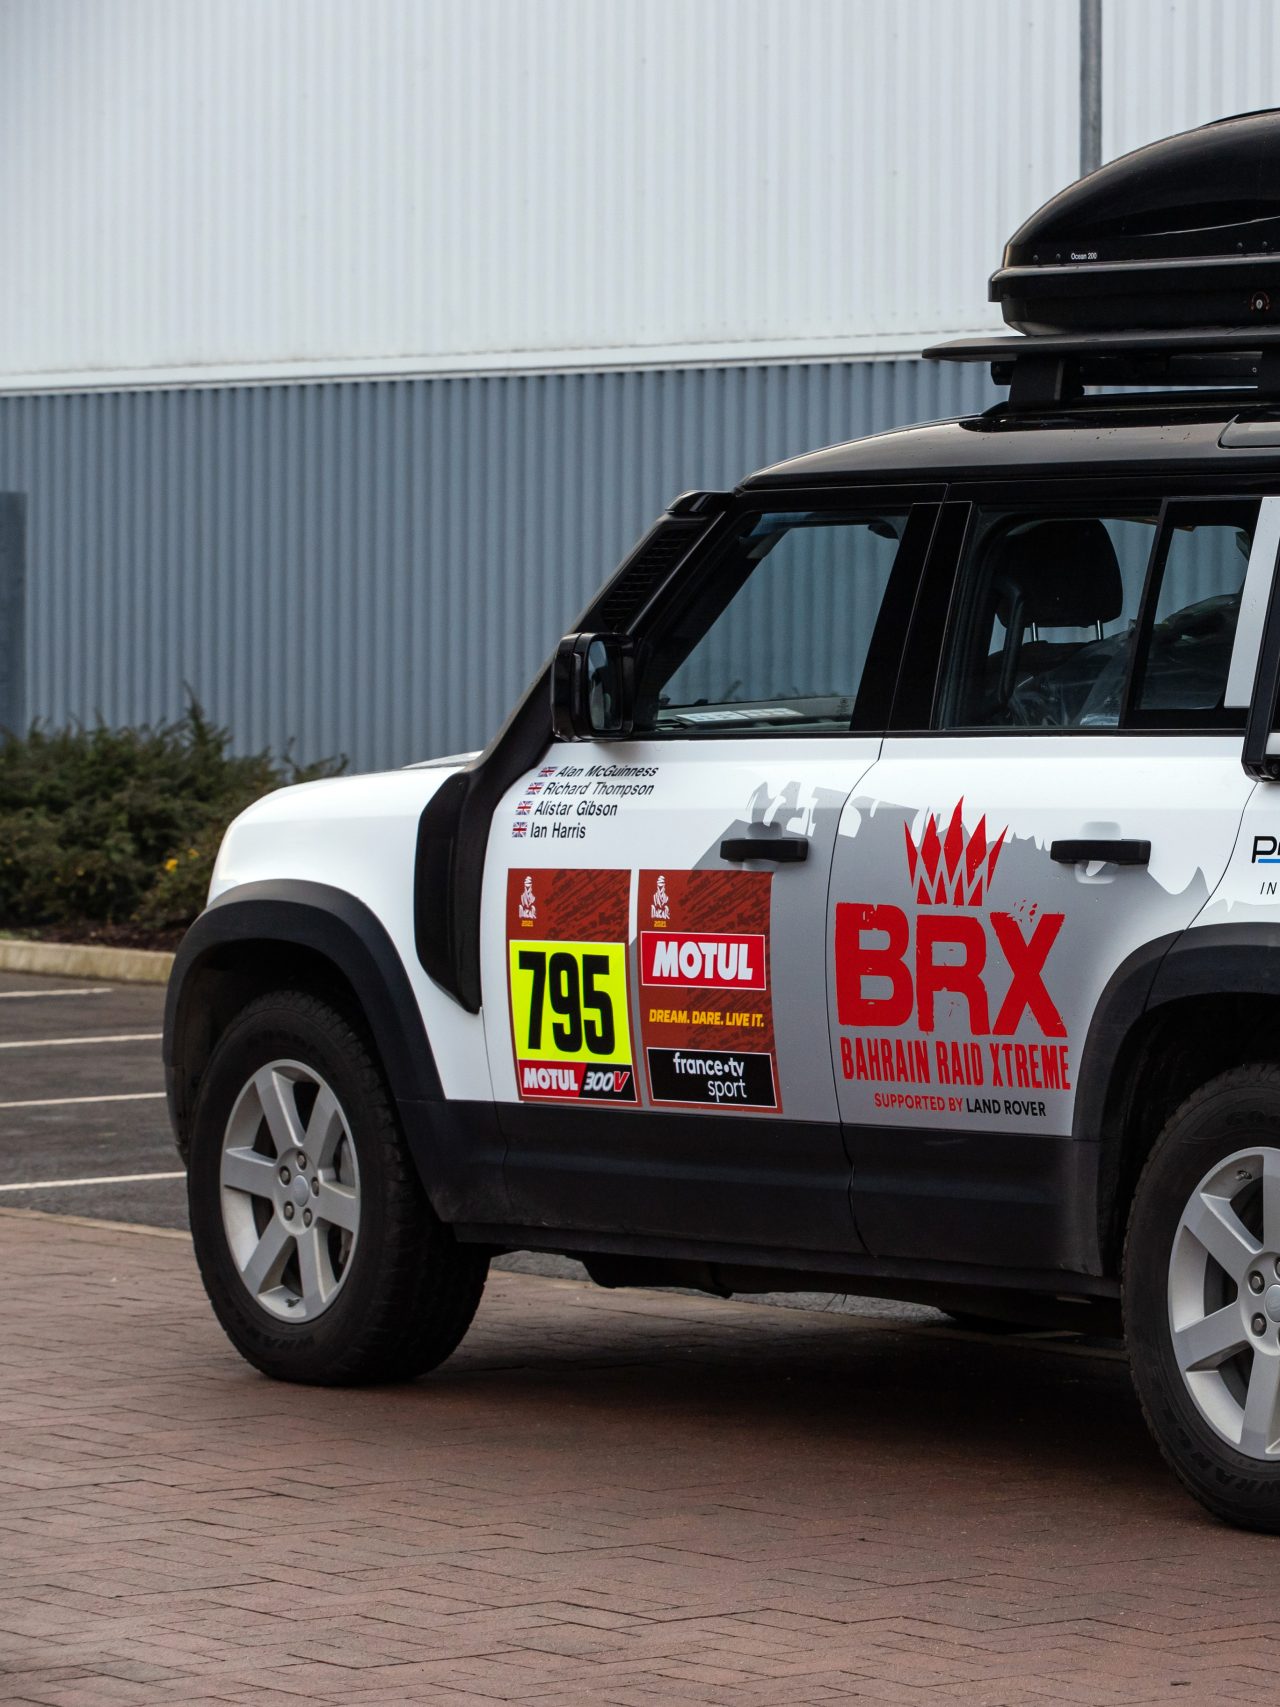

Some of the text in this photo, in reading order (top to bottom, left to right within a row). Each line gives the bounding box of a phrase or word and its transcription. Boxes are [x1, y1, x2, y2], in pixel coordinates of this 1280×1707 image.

[555, 765, 659, 778] Alan McGuinness
[543, 782, 655, 797] Richard Thompson
[534, 801, 618, 816] Alistar Gibson
[530, 822, 586, 839] Ian Harris
[652, 941, 753, 981] MOTUL
[834, 902, 1068, 1038] BRX
[518, 950, 616, 1056] 795
[649, 1009, 765, 1028] DREAM. DARE. LIVE IT.
[840, 1036, 1072, 1090] BAHRAIN RAID XTREME
[523, 1067, 630, 1092] MOTUL 300V
[708, 1079, 747, 1102] sport
[874, 1092, 1047, 1117] SUPPORTED BY LAND ROVER
